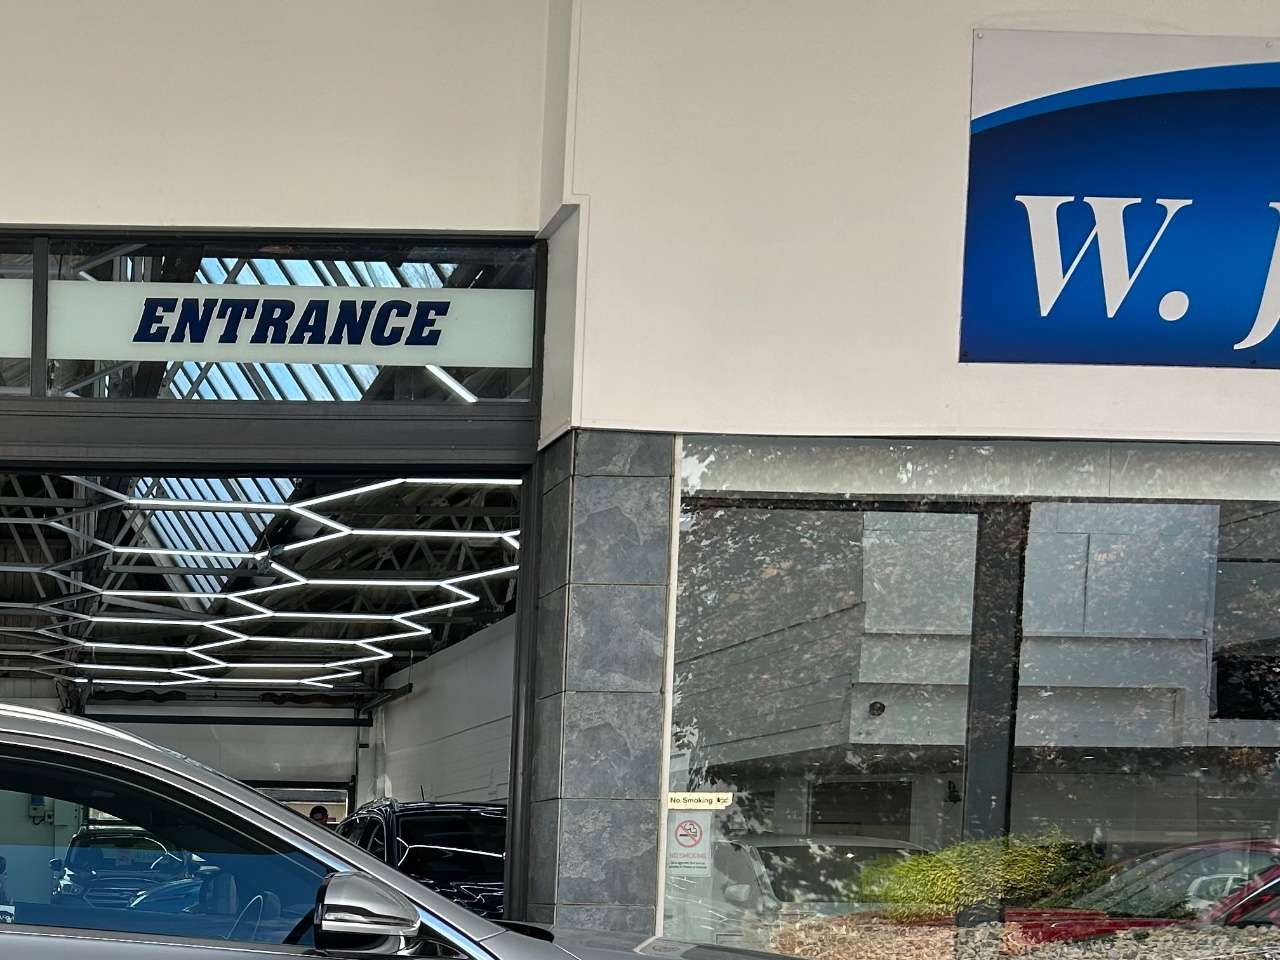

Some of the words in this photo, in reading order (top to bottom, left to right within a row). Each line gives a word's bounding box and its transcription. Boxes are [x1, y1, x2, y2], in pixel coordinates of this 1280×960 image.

[1014, 195, 1193, 321] W.
[132, 297, 451, 346] ENTRANCE
[682, 797, 713, 805] Smoking
